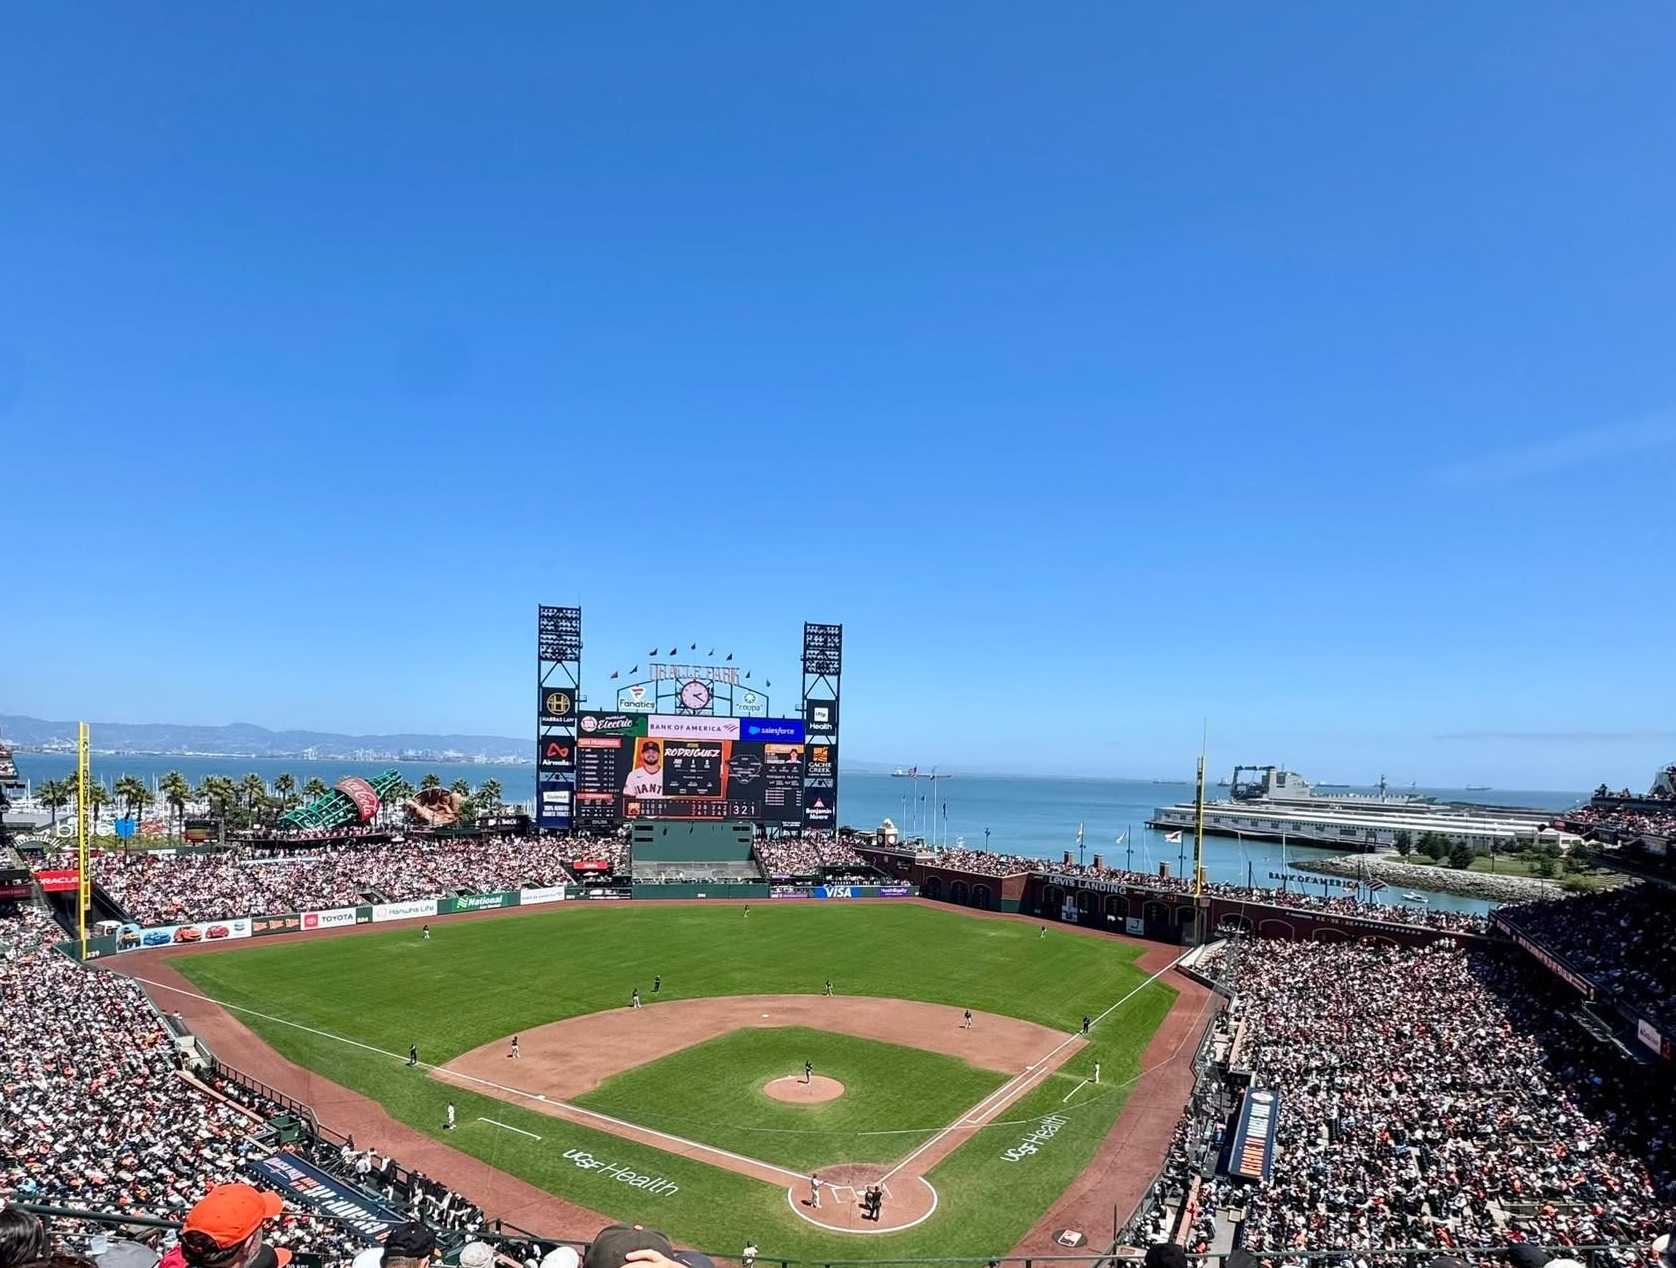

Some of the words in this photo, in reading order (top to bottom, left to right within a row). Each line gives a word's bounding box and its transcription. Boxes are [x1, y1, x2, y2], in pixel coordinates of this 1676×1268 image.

[707, 667, 740, 686] PARK
[620, 699, 655, 709] Fanatics
[809, 722, 832, 730] Health
[761, 727, 795, 736] salesforce
[664, 748, 720, 757] RODRIGUEZ
[733, 805, 740, 815] 3
[741, 805, 748, 815] 2
[750, 805, 755, 815] 1
[39, 876, 79, 885] RACLE
[1269, 872, 1294, 881] BANK
[1298, 875, 1311, 883] OF
[1312, 877, 1359, 888] AMERICA
[825, 886, 852, 898] VISA
[1078, 881, 1127, 894] LANDING
[468, 895, 503, 906] National
[322, 913, 353, 922] TOYOTA
[1021, 1115, 1071, 1145] Health
[596, 1162, 679, 1197] Health
